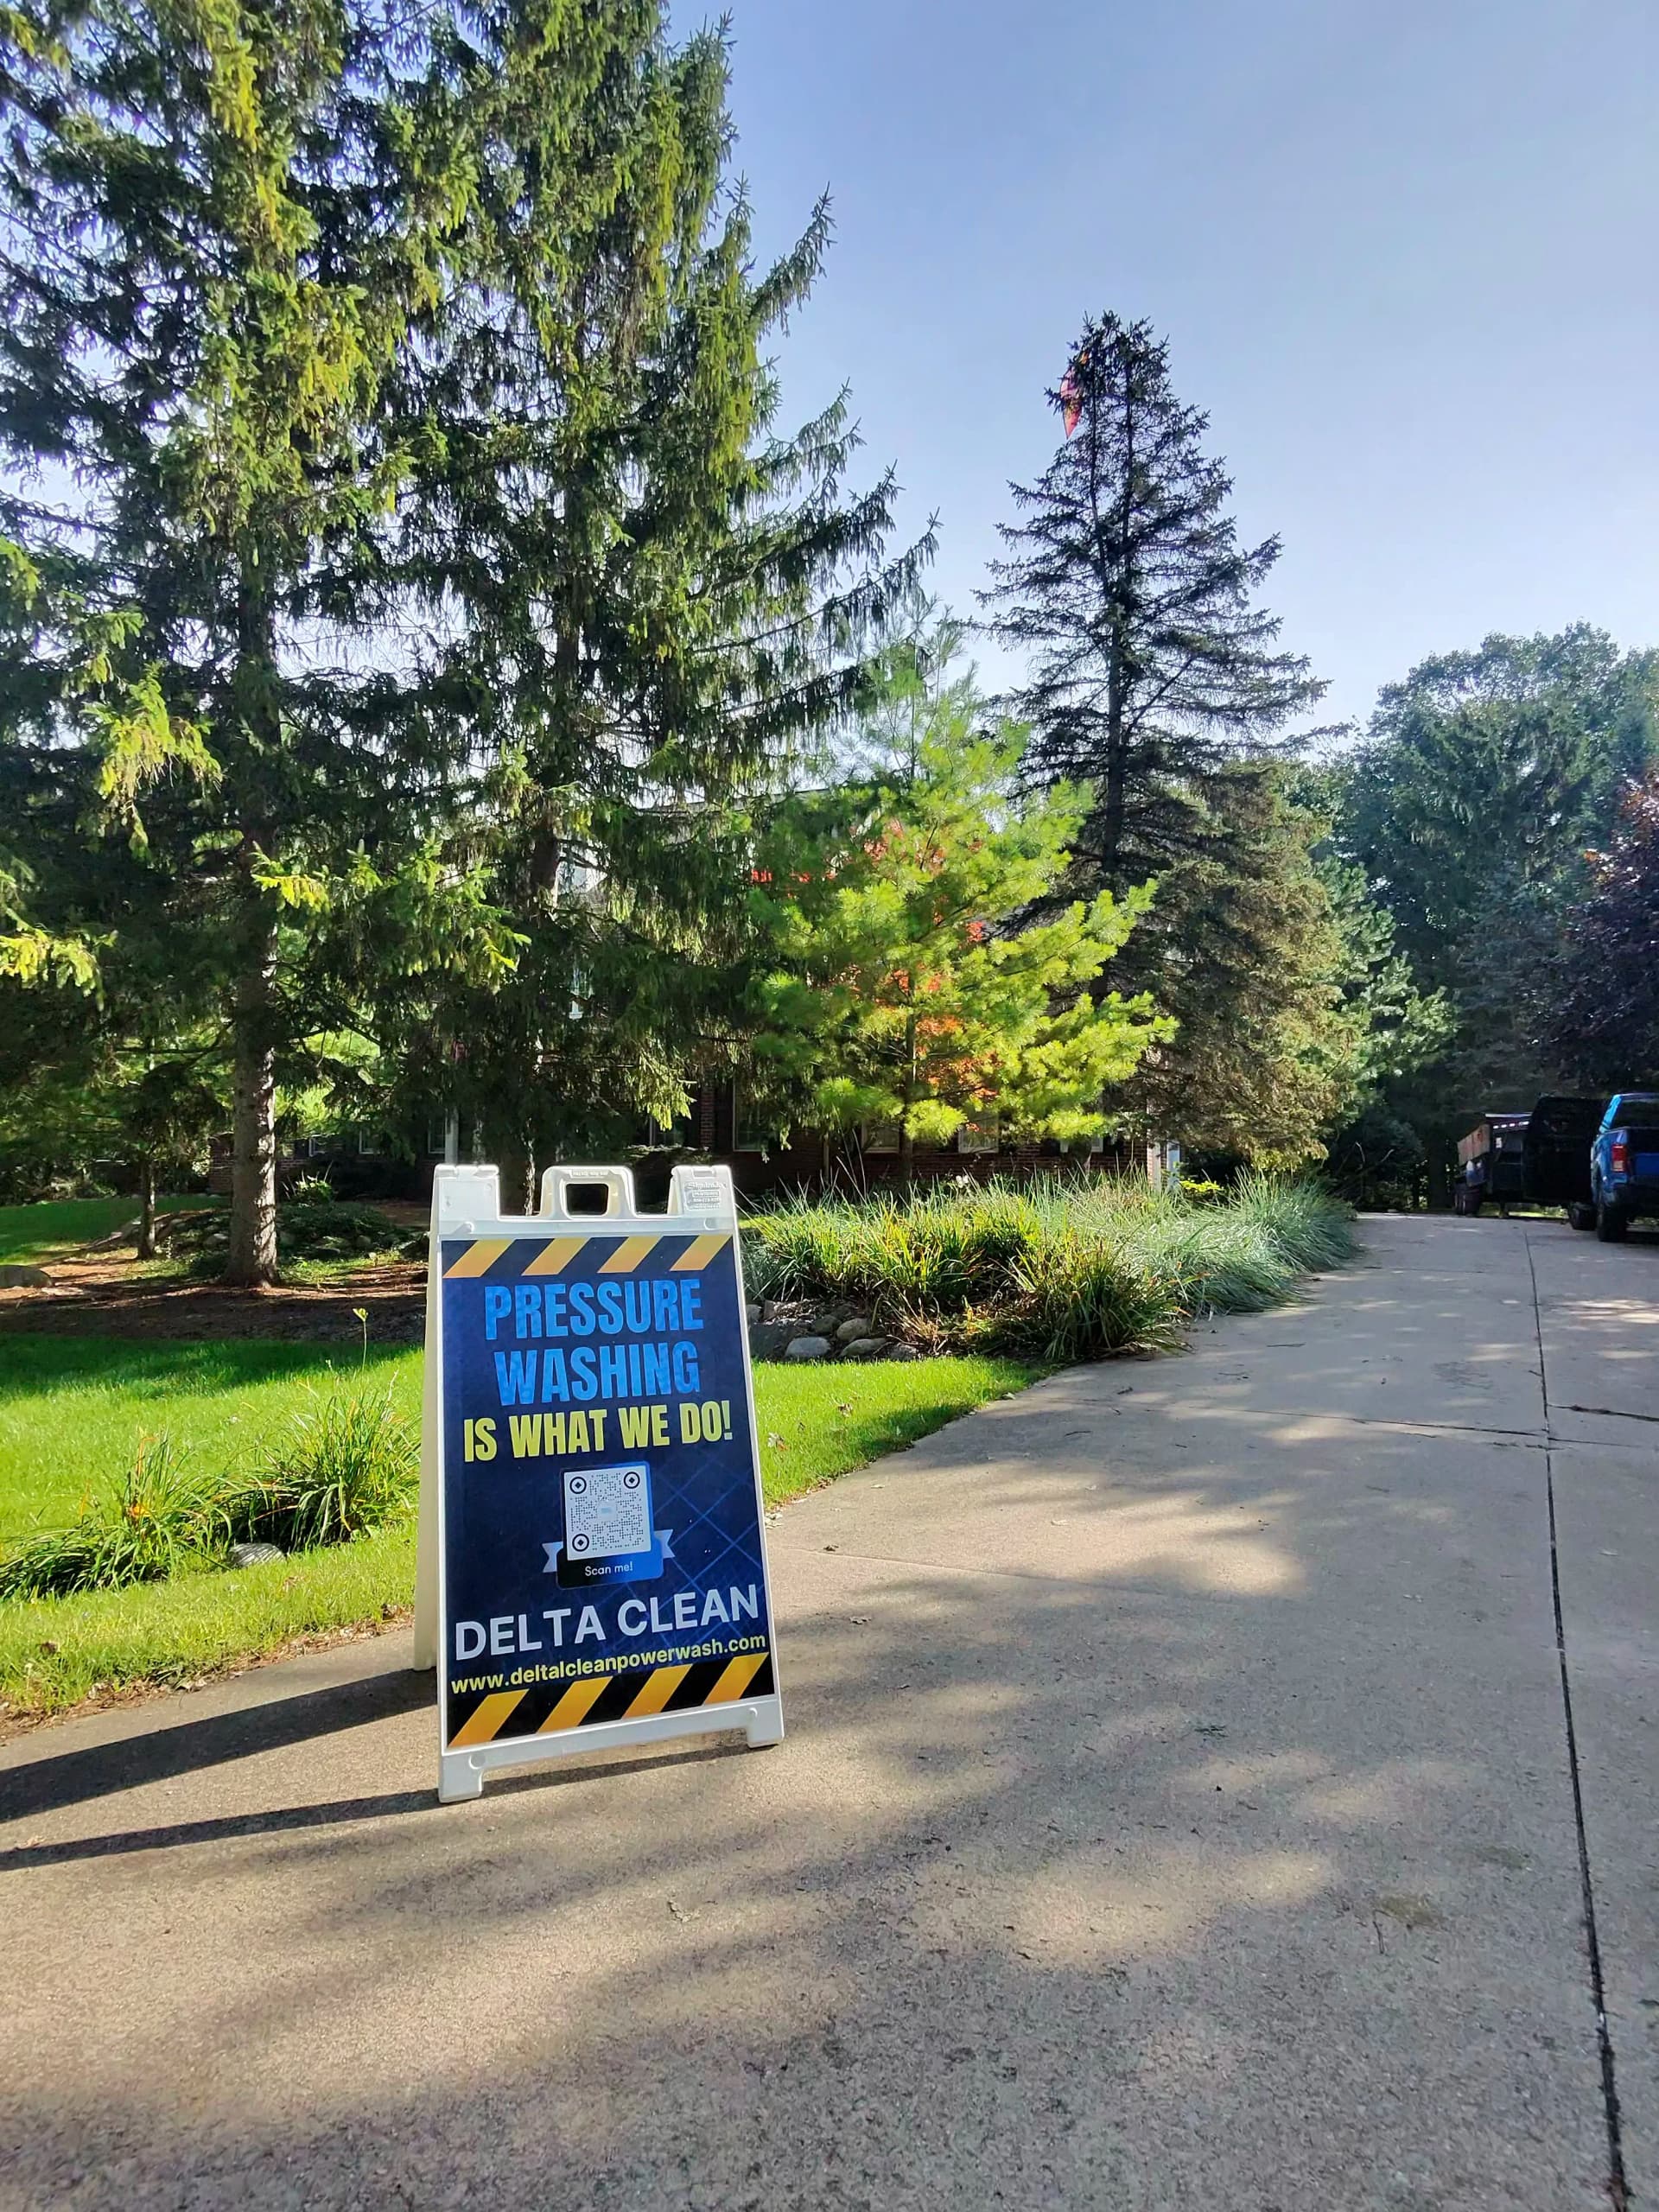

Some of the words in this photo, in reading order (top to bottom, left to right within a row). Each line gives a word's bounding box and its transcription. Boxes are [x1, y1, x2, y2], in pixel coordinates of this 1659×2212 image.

[484, 1279, 704, 1341] PRESSURE
[494, 1340, 700, 1406] WASHING
[463, 1418, 498, 1462] IS
[509, 1408, 607, 1458] WHAT
[618, 1404, 669, 1448] WE
[679, 1400, 732, 1443] DO!
[584, 1565, 612, 1577] Scan
[614, 1561, 633, 1573] me!
[455, 1605, 606, 1661] DELTA
[618, 1584, 759, 1637] CLEAN
